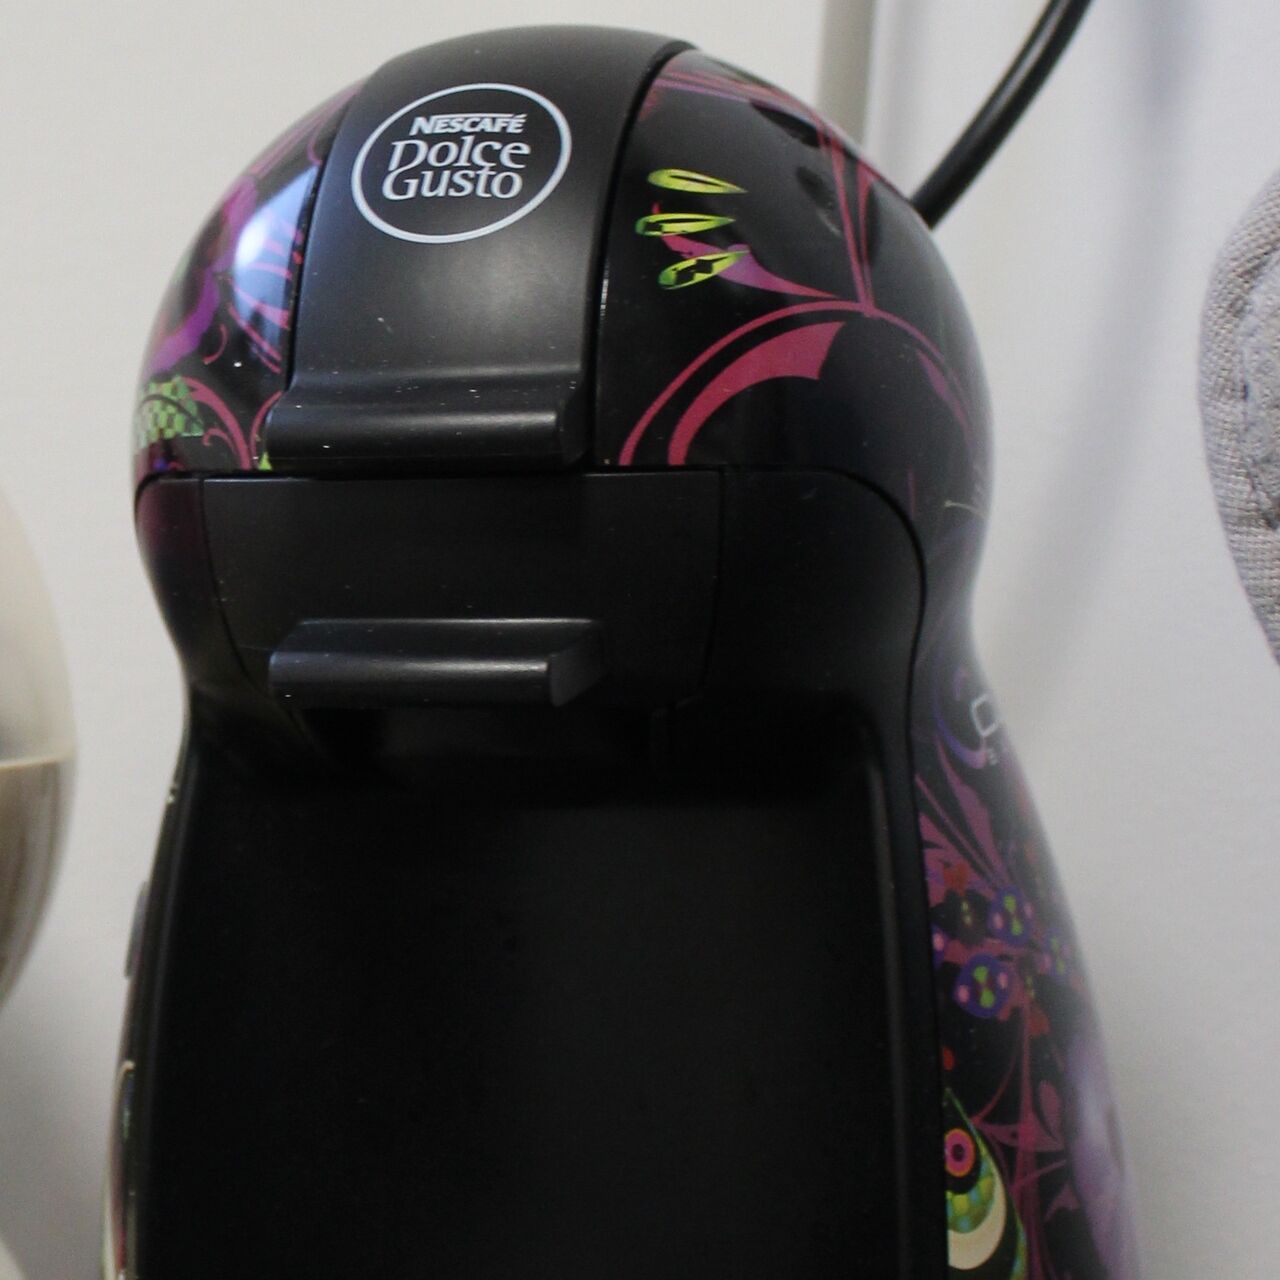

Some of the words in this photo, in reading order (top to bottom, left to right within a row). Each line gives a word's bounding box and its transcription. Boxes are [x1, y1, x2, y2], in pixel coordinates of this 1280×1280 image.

[409, 113, 527, 136] NESCAFÉ
[388, 135, 531, 171] Dolce
[382, 167, 523, 201] Gusto
